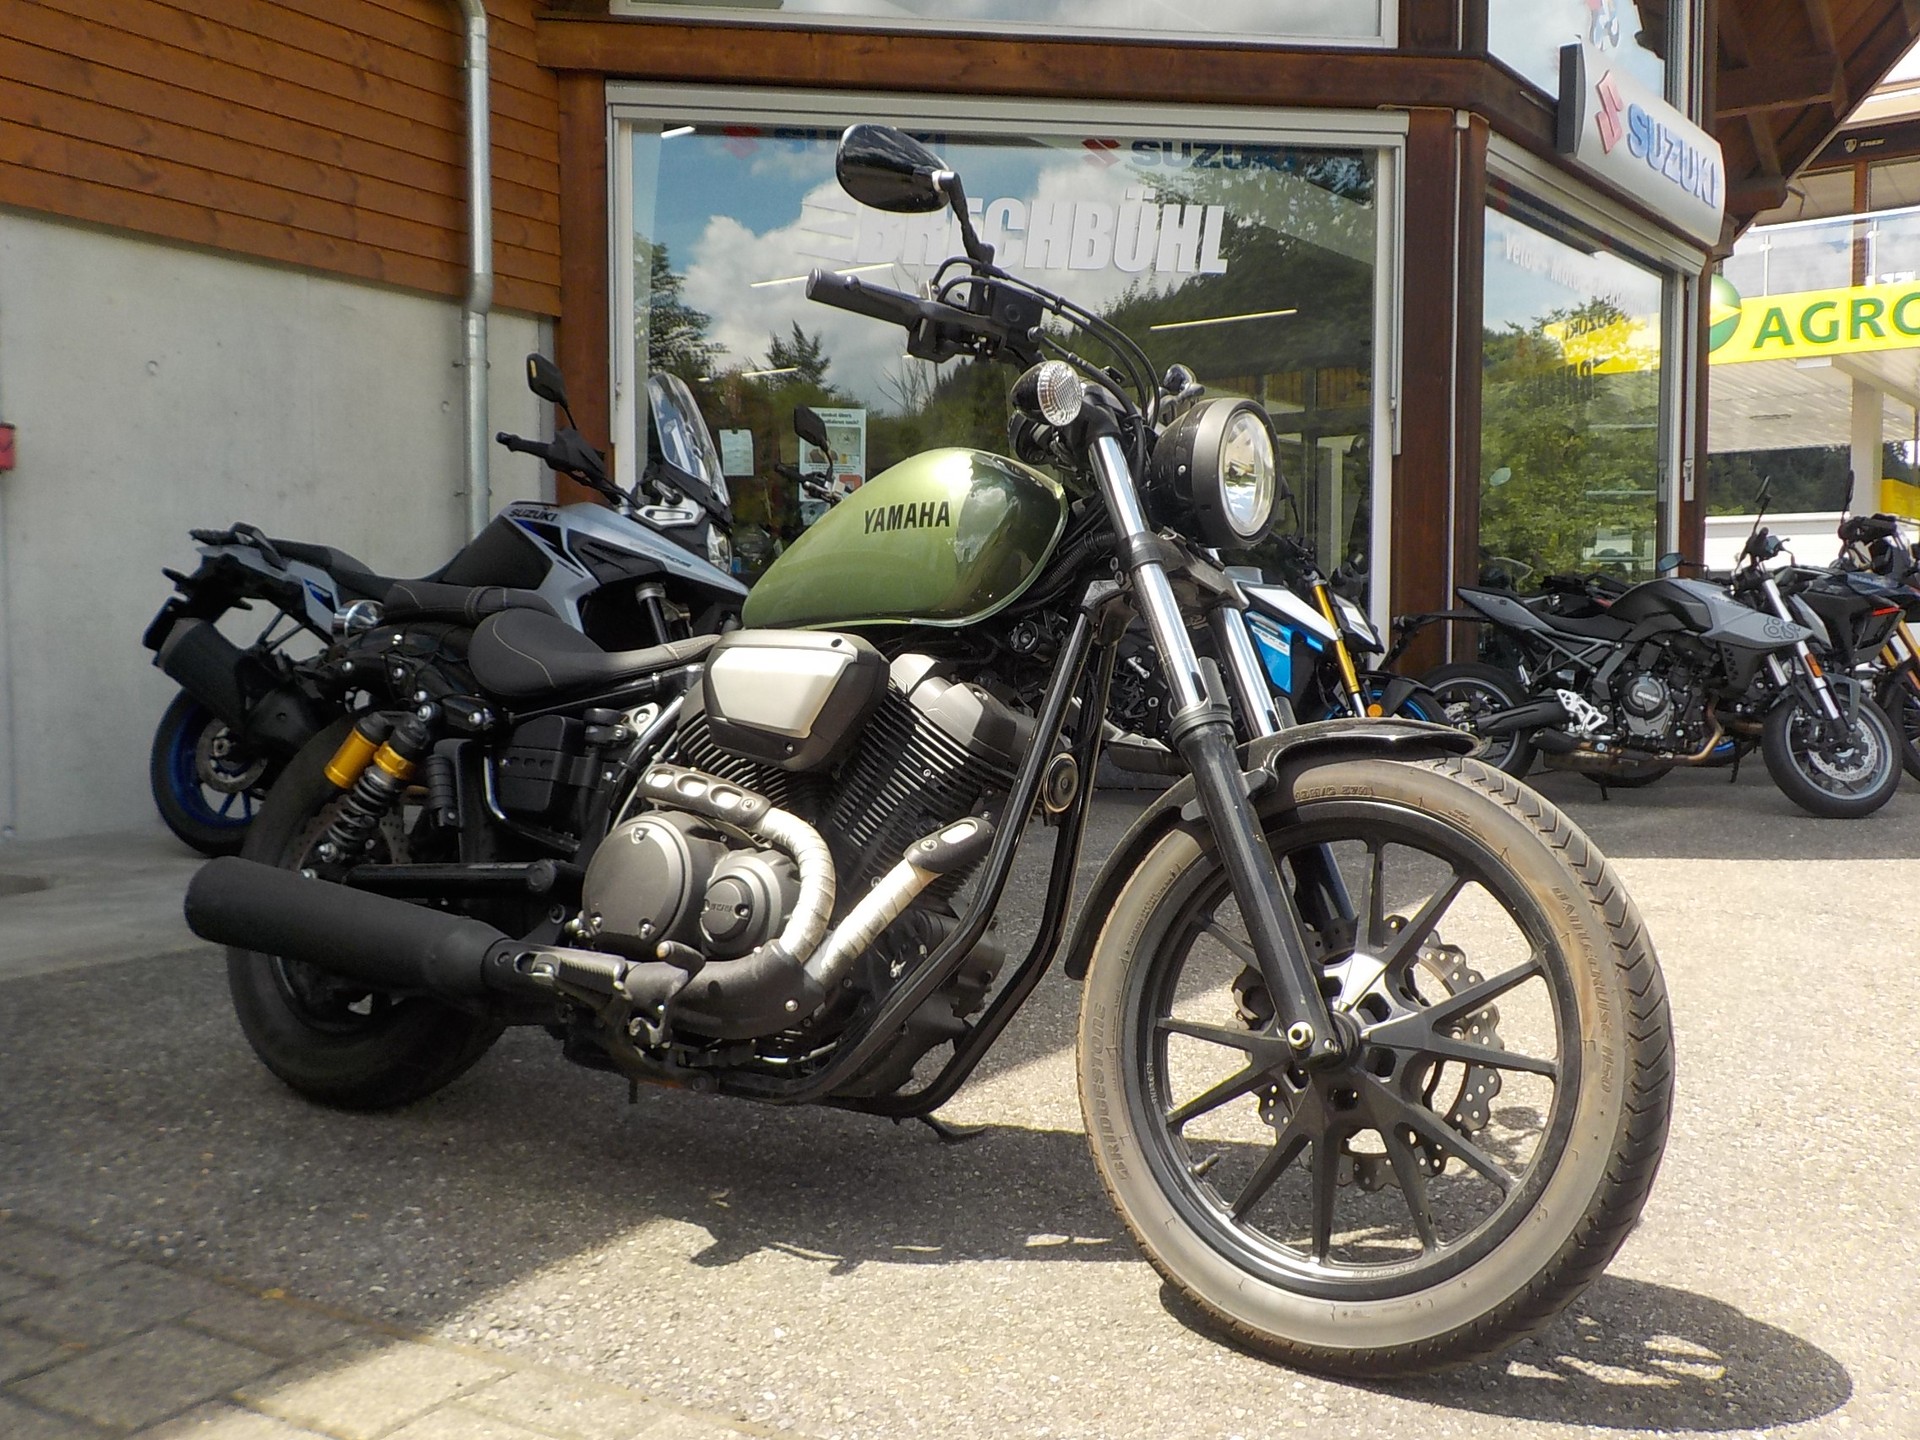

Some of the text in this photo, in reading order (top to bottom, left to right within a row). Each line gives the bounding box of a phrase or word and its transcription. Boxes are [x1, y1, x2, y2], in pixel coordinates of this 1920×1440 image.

[1626, 103, 1719, 209] SUZUKI
[508, 507, 558, 522] SUZUKI
[864, 501, 950, 535] YAMAHA
[1089, 1002, 1131, 1182] BRIDGESTONE
